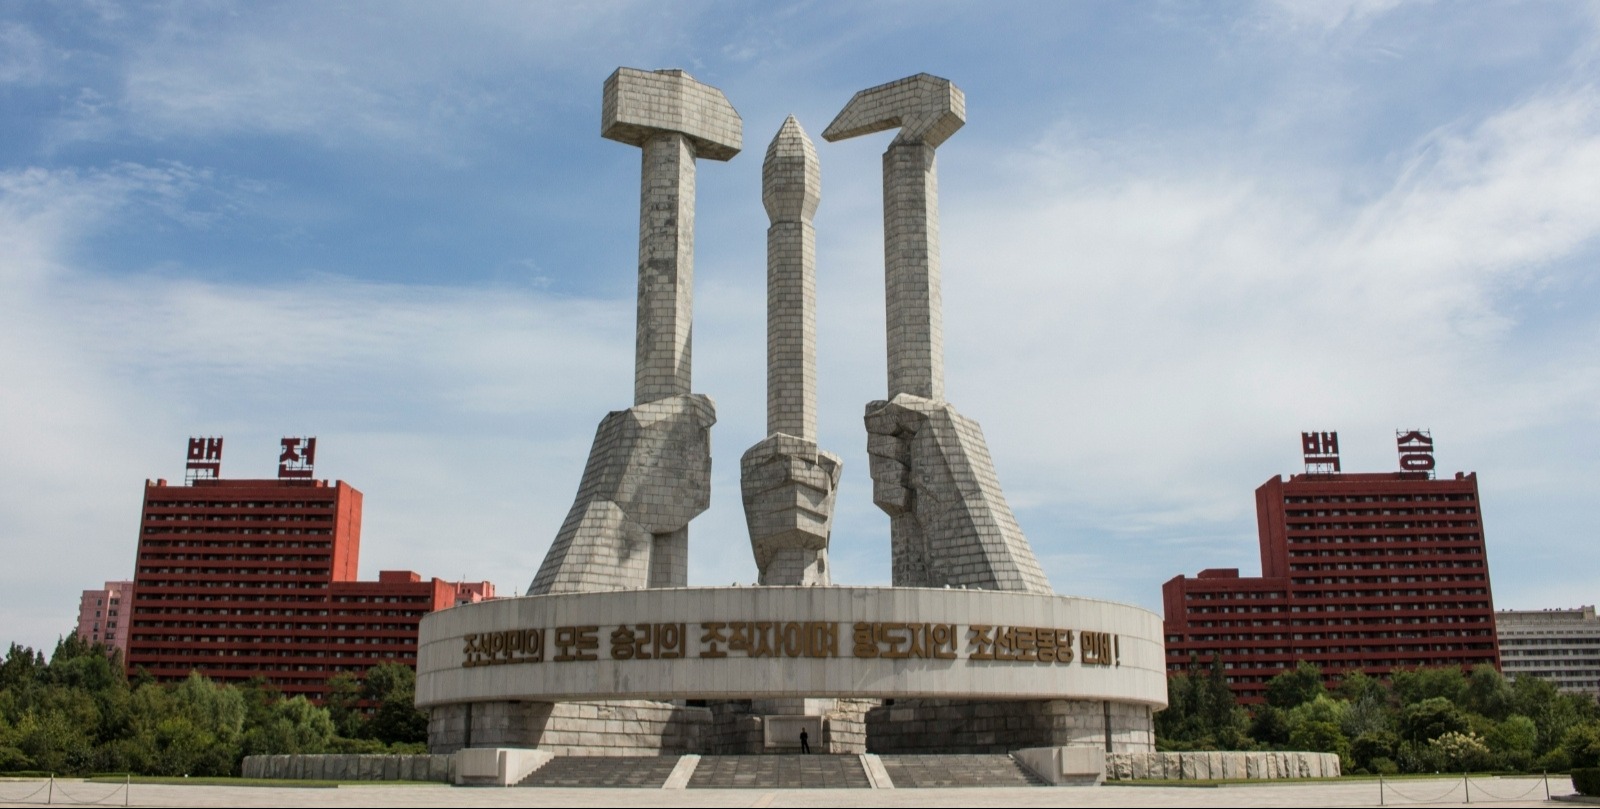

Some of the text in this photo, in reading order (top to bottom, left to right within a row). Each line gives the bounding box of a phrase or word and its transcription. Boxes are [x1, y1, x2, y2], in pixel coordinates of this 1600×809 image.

[462, 628, 545, 668] 조선인민의
[553, 625, 599, 662] 모든
[610, 622, 687, 660] 승리의
[699, 621, 839, 659] 조직자이며
[852, 621, 958, 660] 향도자인
[969, 624, 1075, 664] 조선로동당
